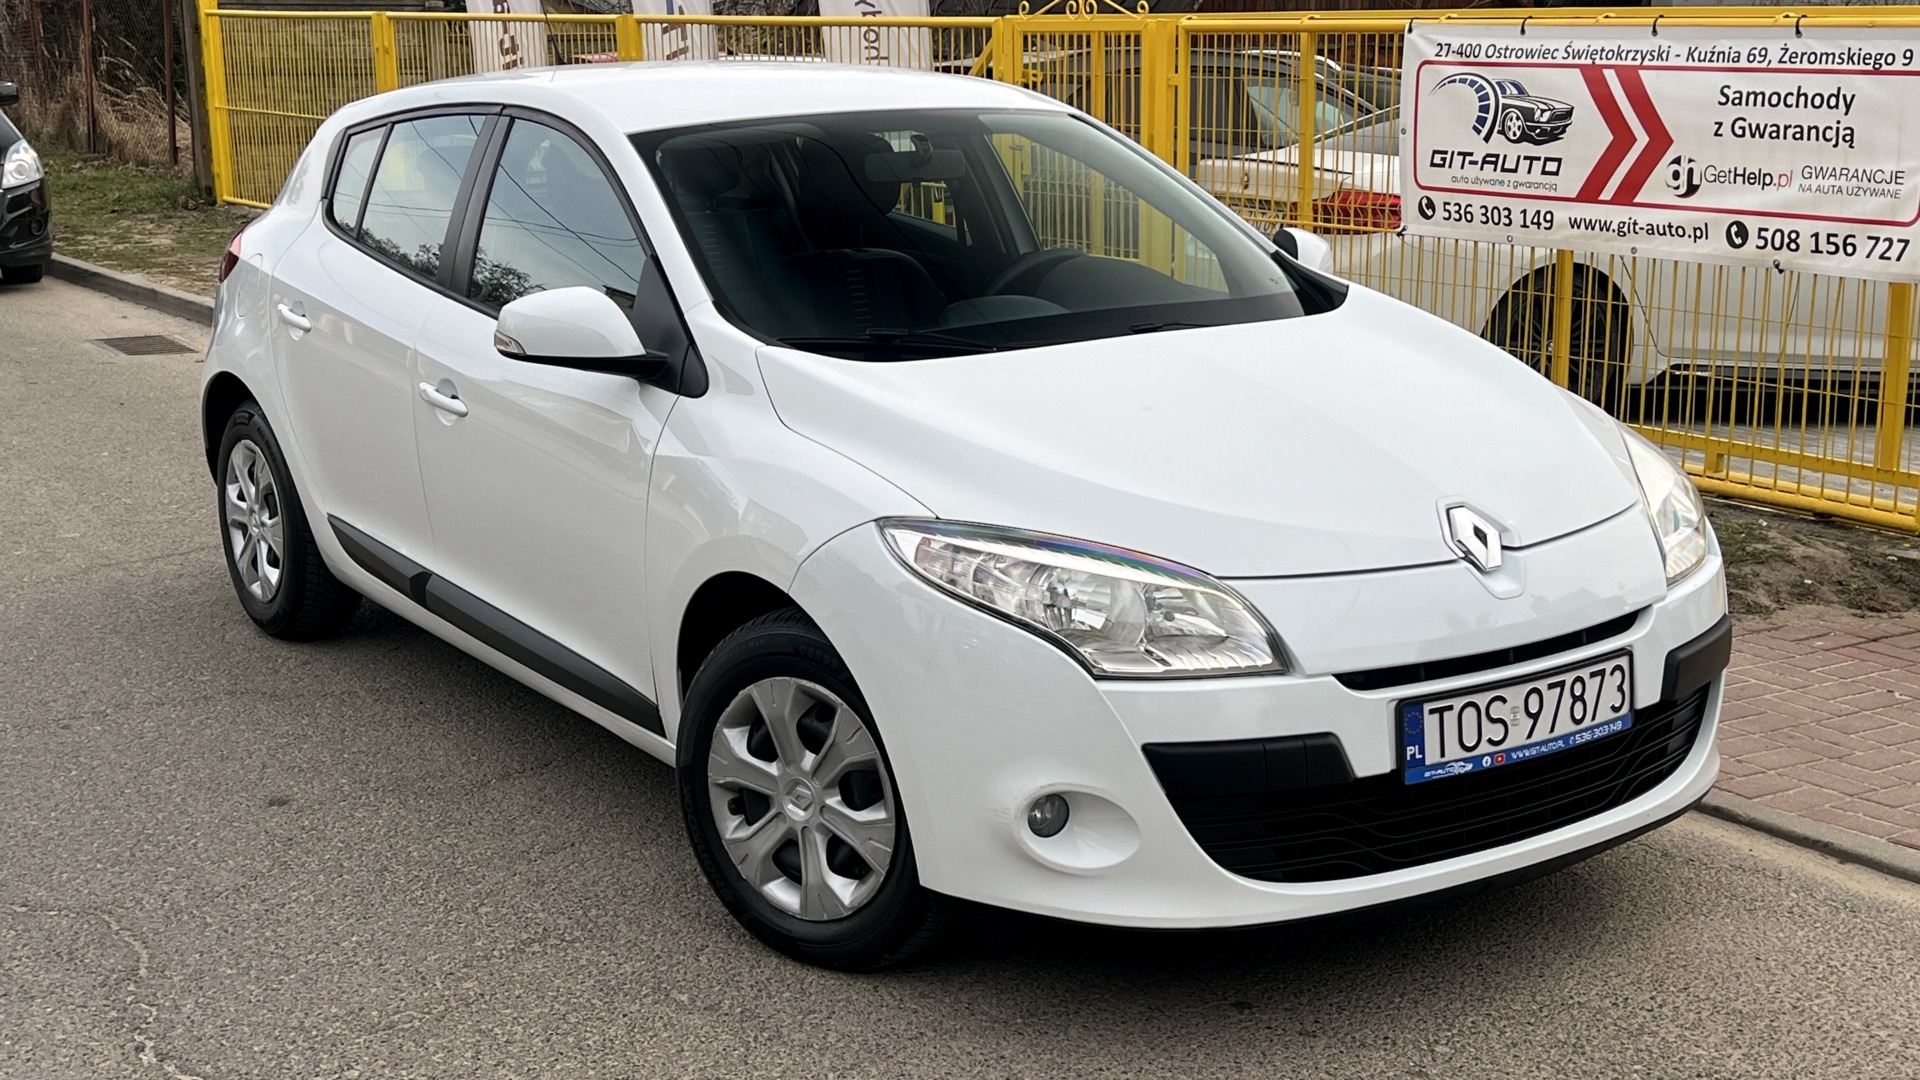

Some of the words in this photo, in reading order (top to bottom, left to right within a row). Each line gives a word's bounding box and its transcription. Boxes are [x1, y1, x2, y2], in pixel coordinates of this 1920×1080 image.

[1434, 43, 1482, 58] 27-400
[1485, 43, 1559, 60] Ostrowiec
[1561, 41, 1671, 66] Świętokrzyski
[1686, 45, 1741, 63] Kuźnia
[1746, 47, 1772, 67] 69,
[1778, 43, 1896, 70] Żeromskiego
[1901, 48, 1914, 67] 9
[1717, 84, 1856, 116] Samochody
[1713, 121, 1724, 138] z
[1730, 117, 1856, 149] Gwarancją
[1429, 149, 1563, 177] GIT-AUTO
[1801, 165, 1905, 185] GWARANCJE
[1451, 174, 1469, 184] auta
[1471, 176, 1505, 188] używane
[1512, 180, 1557, 192] gwarancją
[1703, 164, 1794, 192] GetHelp.pl
[1798, 183, 1812, 193] NA
[1814, 185, 1843, 196] AUTA
[1442, 201, 1474, 224] 536
[1479, 205, 1513, 227] 303
[1519, 208, 1554, 231] 149
[1568, 216, 1708, 243] www.git-auto.pl
[1755, 226, 1801, 253] 508
[1809, 231, 1857, 257] 156
[1864, 235, 1911, 262] 727
[1428, 694, 1509, 759] TOS
[1523, 663, 1626, 740] 97873
[1406, 745, 1423, 760] PL
